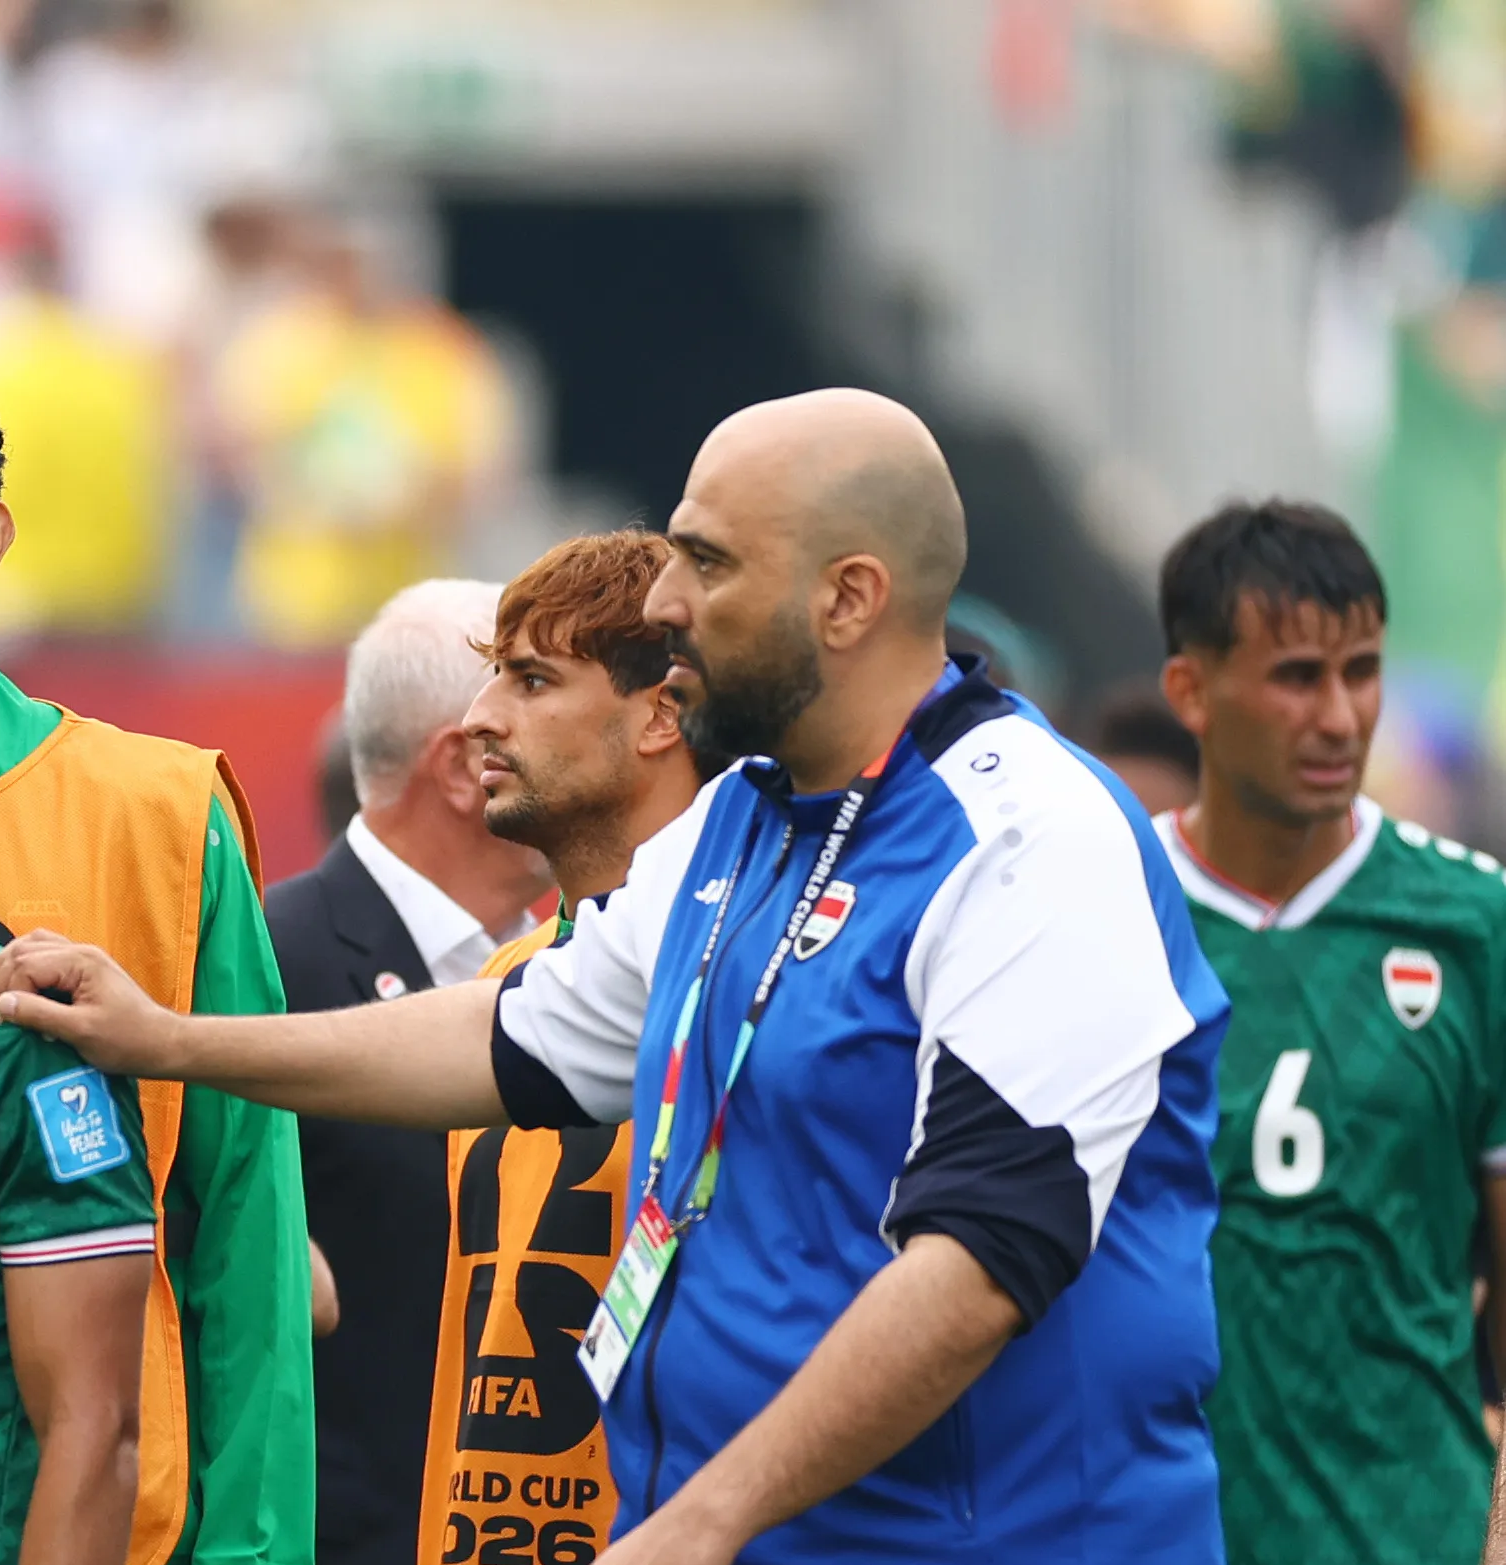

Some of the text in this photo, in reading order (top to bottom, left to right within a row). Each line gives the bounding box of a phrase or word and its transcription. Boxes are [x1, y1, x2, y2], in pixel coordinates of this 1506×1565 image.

[832, 789, 865, 832] FIFA
[804, 832, 847, 900] WORLD
[787, 898, 813, 940] CUP
[1252, 1048, 1325, 1197] 6
[448, 1469, 601, 1510] RLD CUP
